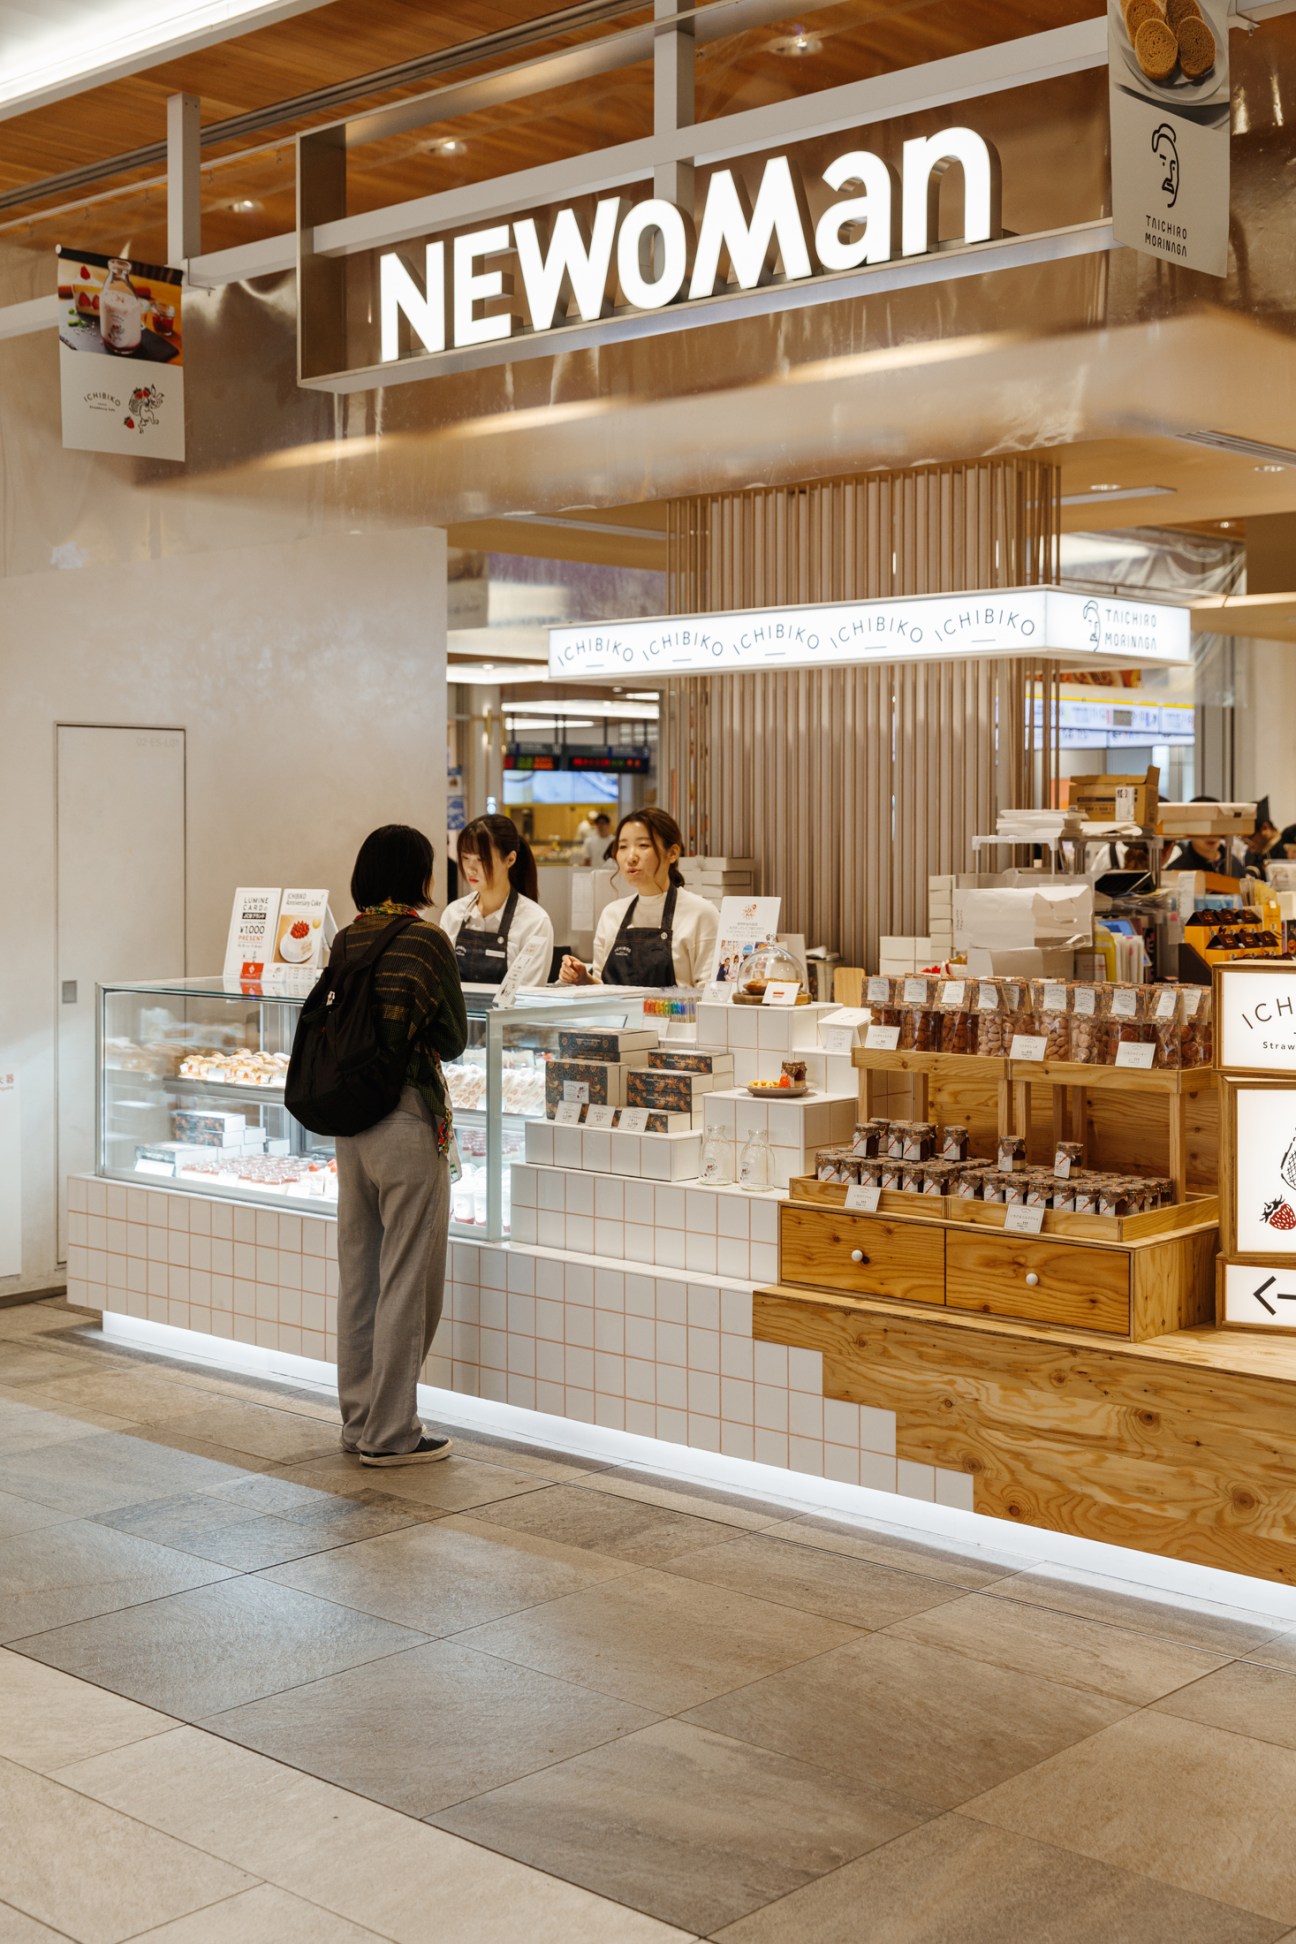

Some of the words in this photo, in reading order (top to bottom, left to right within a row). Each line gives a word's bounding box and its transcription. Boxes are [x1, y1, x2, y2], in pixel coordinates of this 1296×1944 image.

[1145, 214, 1188, 240] TAICHIRO
[1144, 232, 1188, 258] MORINAGA
[83, 392, 121, 407] ICHIBIKO
[1105, 608, 1157, 629] TAICHIRO
[558, 637, 634, 667] ICHIBIKO
[642, 630, 723, 661] ICHIBIKO
[733, 623, 820, 656] ICHIBIKO
[830, 615, 923, 649] ICHIBIKO
[935, 607, 1035, 643] ICHIBIKO
[1104, 632, 1157, 651] MORINAGA
[1242, 996, 1294, 1030] ICH
[1262, 1041, 1296, 1051] Straw
